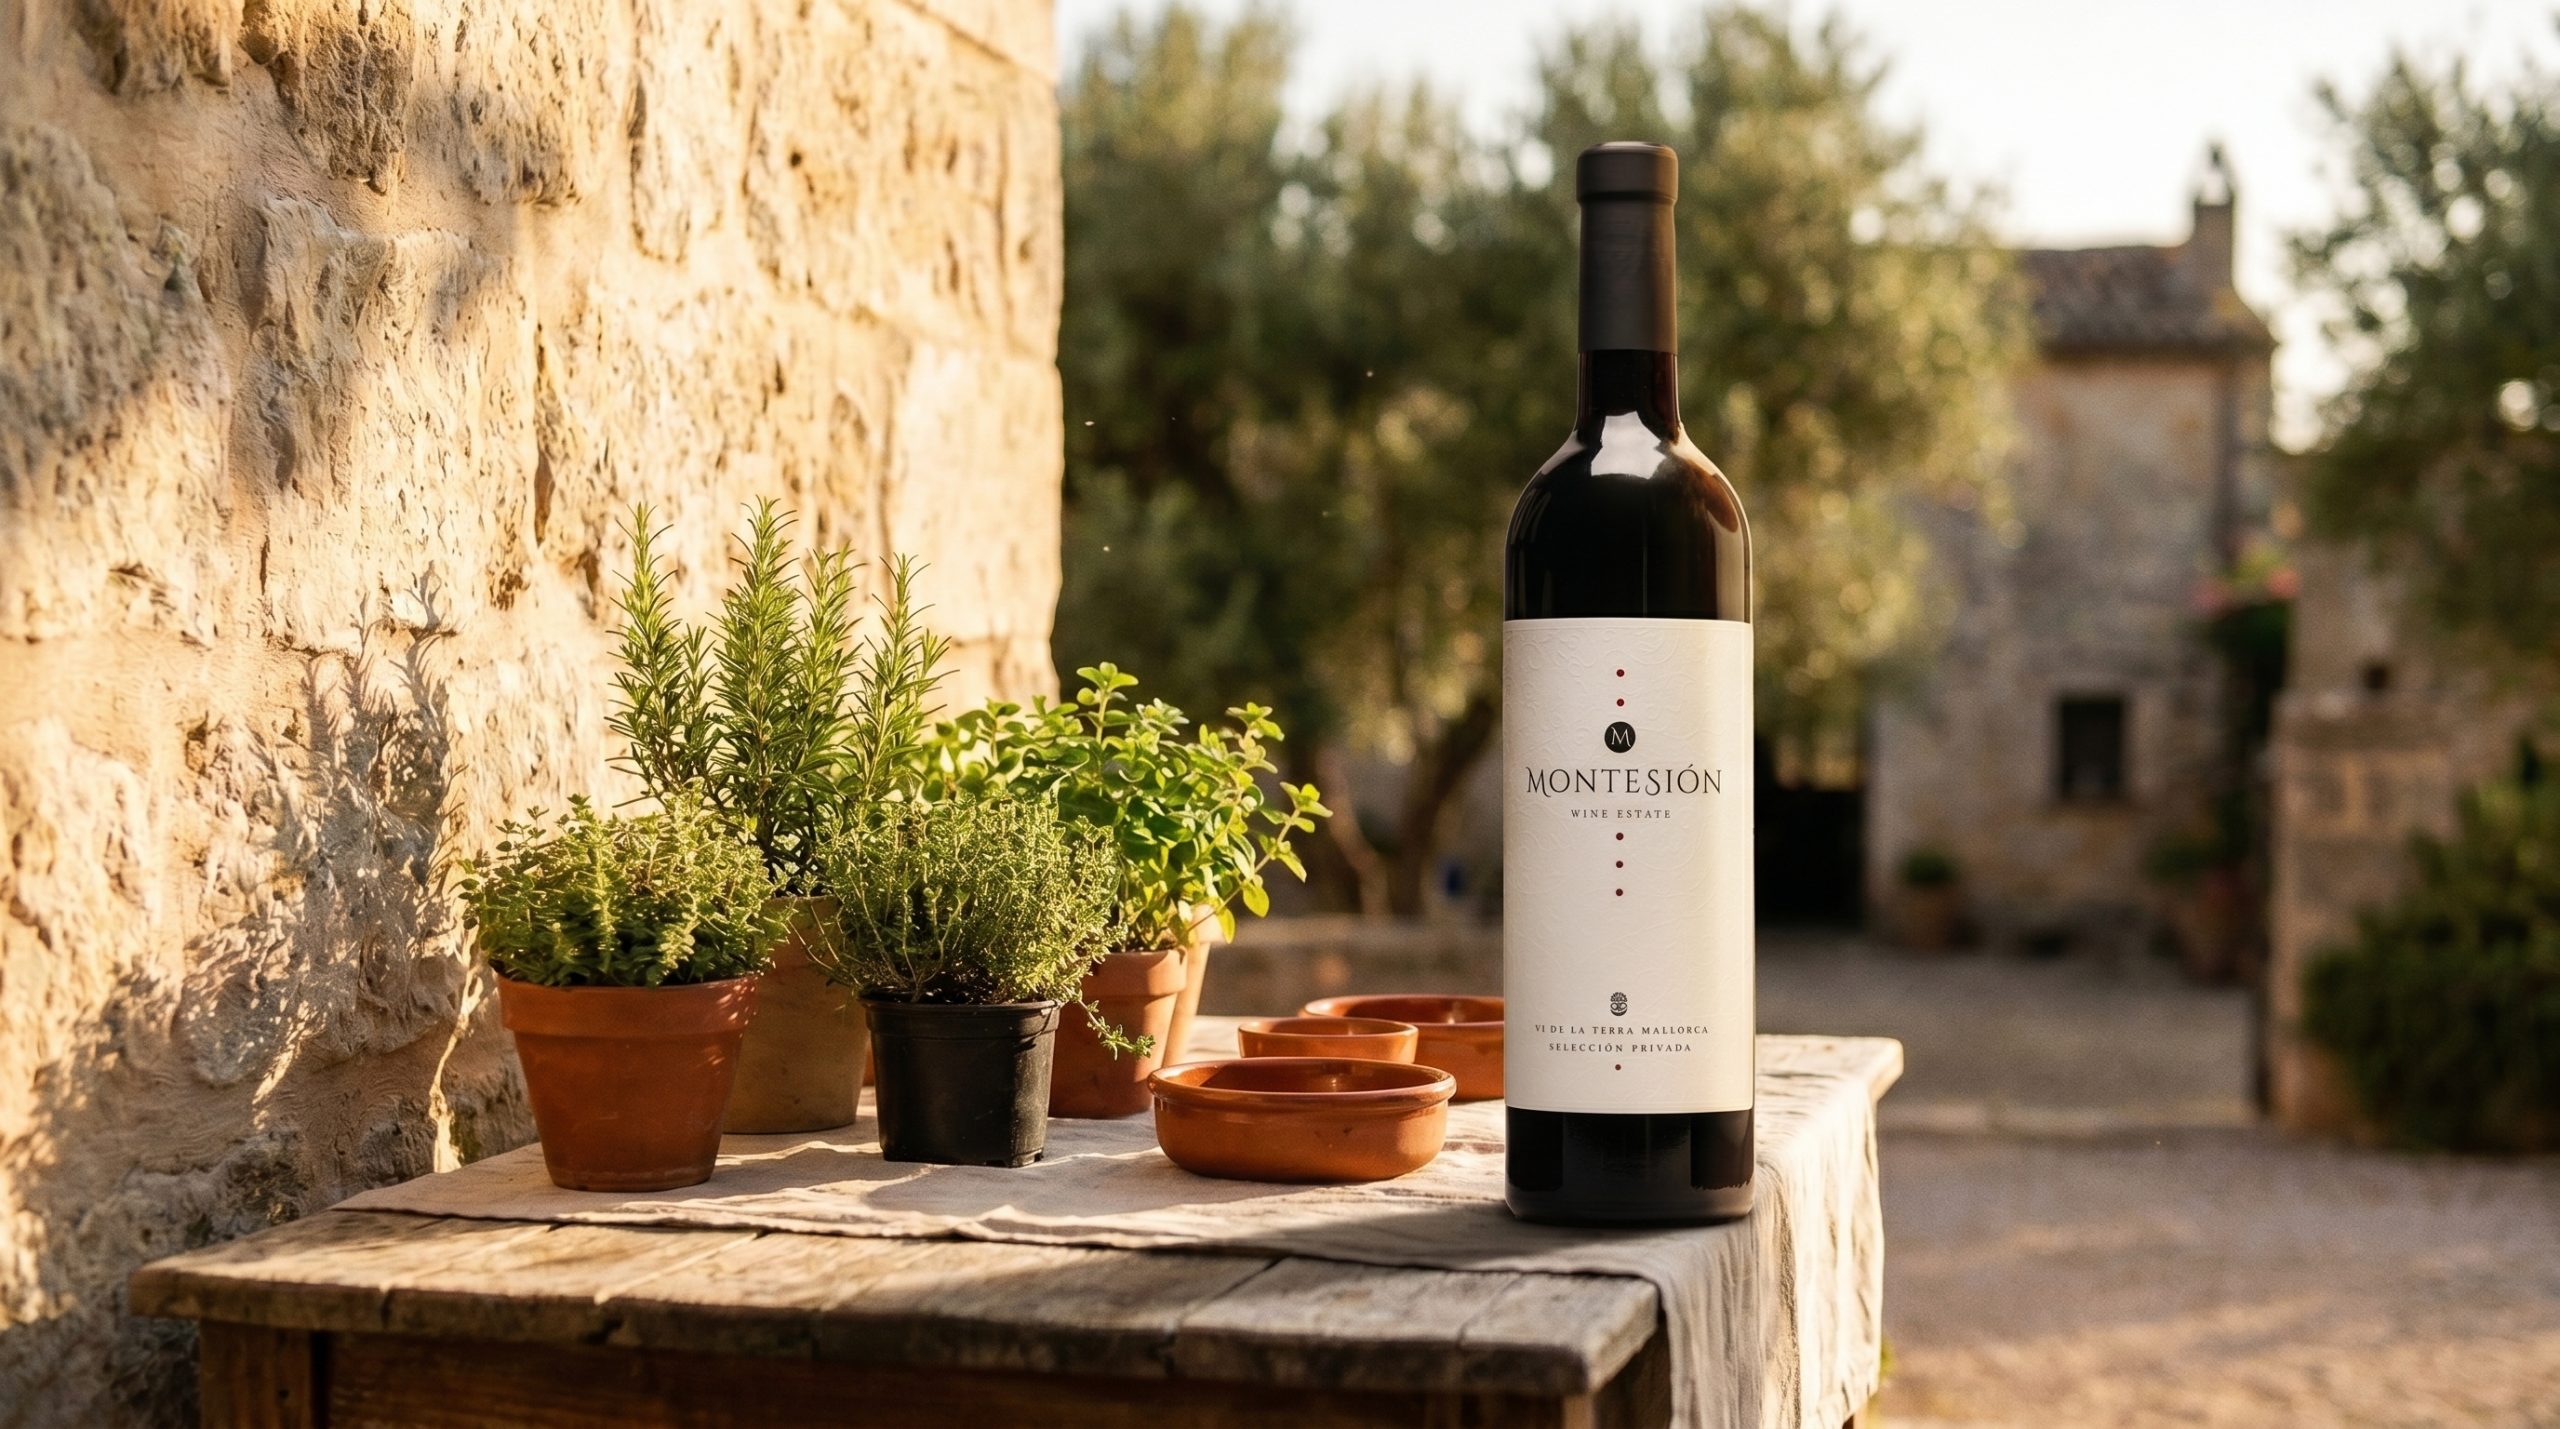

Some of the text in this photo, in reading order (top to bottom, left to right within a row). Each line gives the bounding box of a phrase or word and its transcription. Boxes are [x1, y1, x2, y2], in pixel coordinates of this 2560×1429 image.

[1611, 726, 1631, 747] M
[1525, 764, 1721, 797] MONTESIÓN
[1571, 809, 1671, 819] WINE ESTATE
[1535, 1024, 1708, 1035] VI DE LA TERRA MALLORCA
[1549, 1043, 1691, 1053] SELECCIÓN PRIVADA
